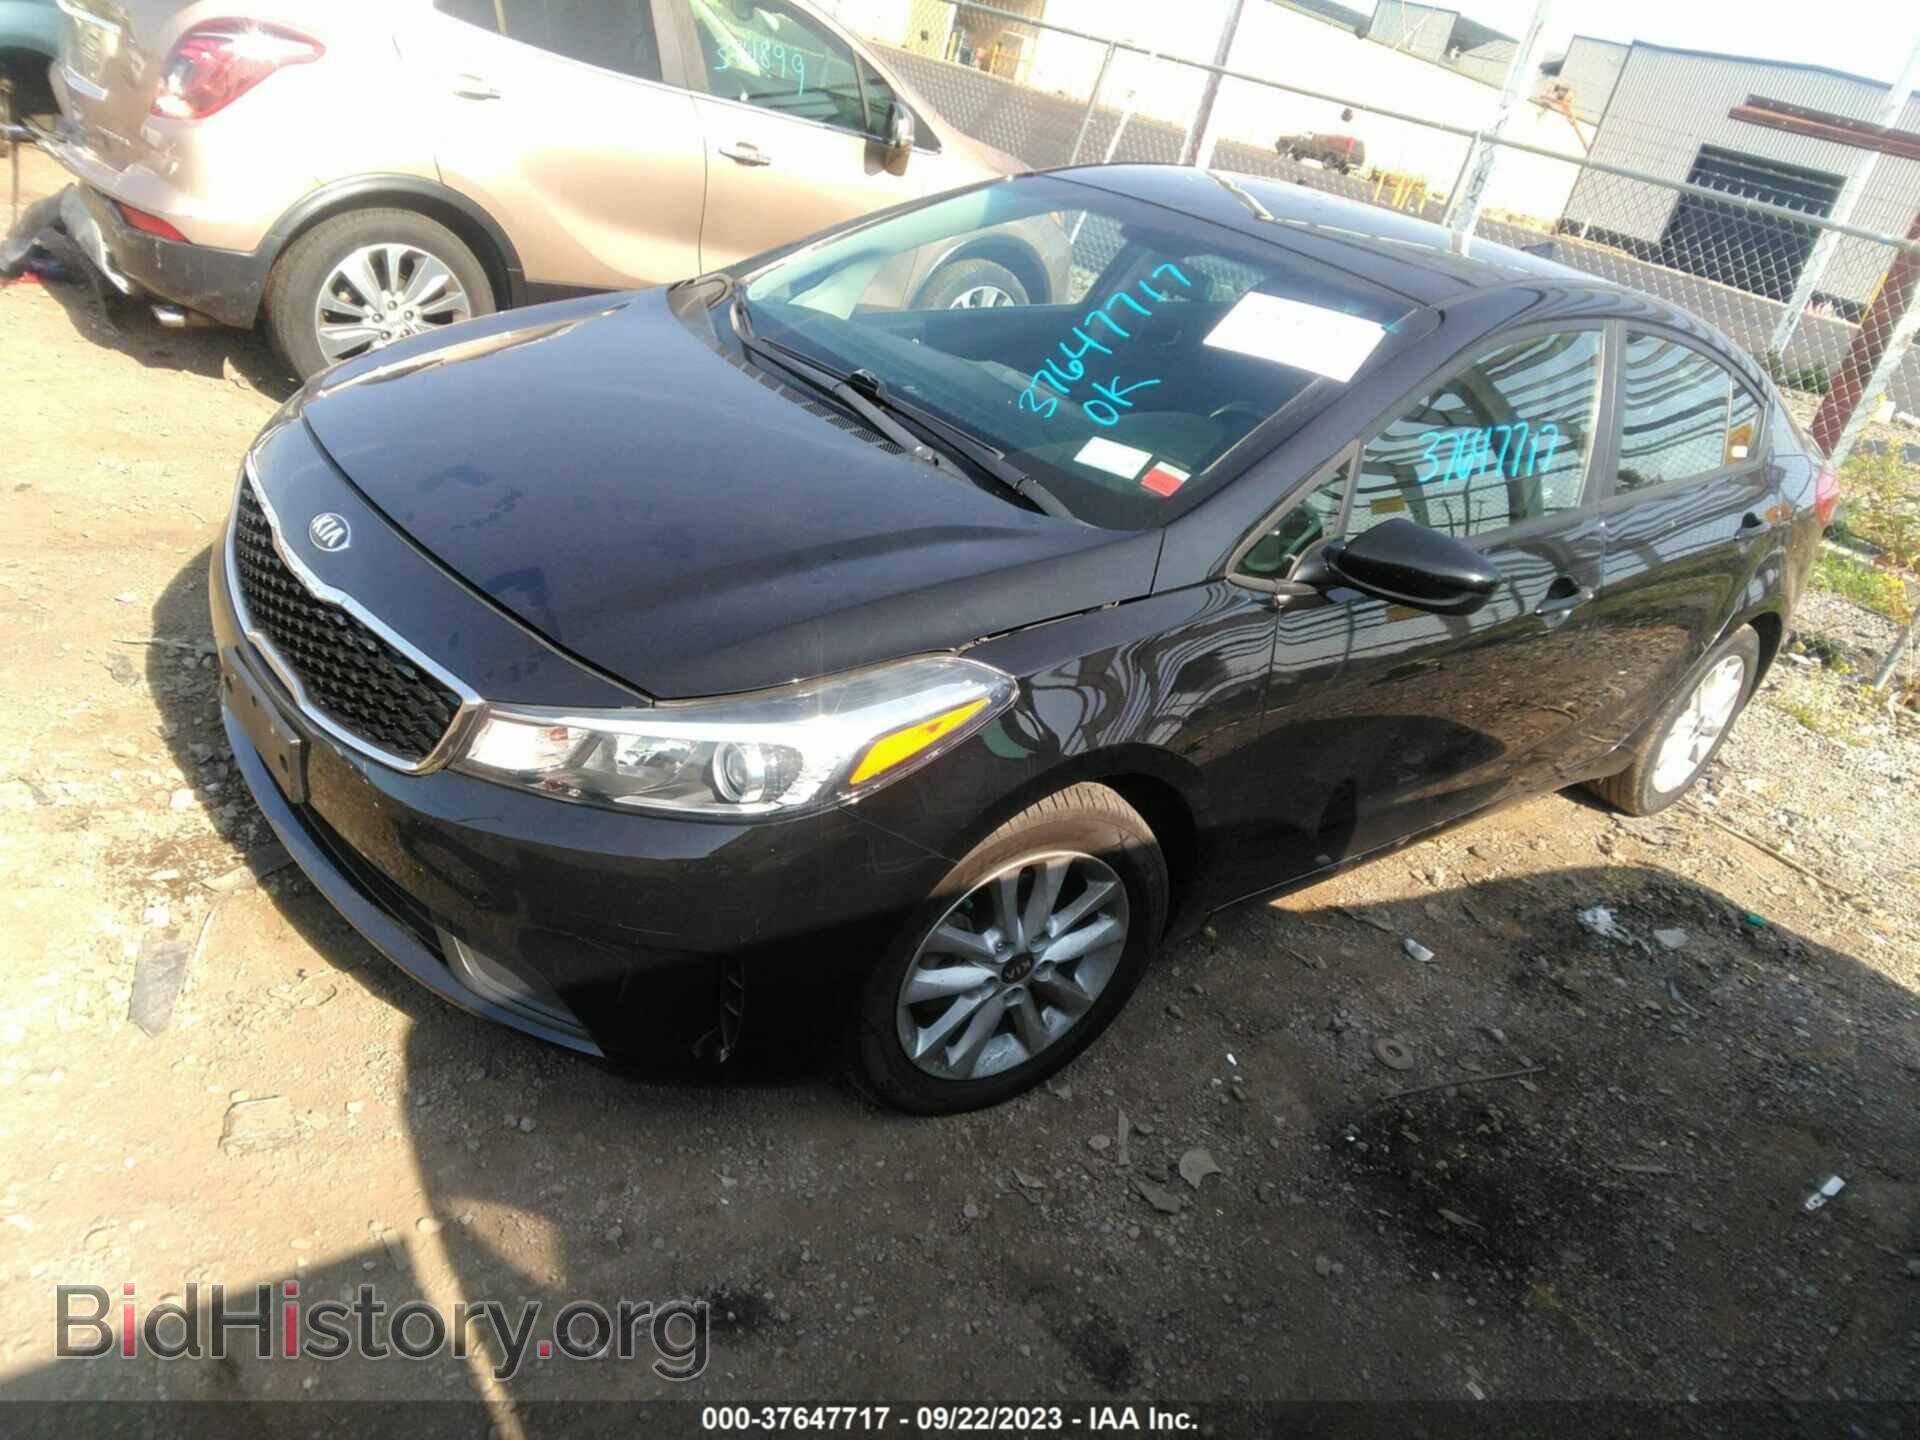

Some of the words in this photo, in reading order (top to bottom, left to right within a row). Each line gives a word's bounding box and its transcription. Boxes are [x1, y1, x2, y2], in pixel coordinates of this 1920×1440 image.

[1018, 263, 1193, 419] 37647717
[1082, 375, 1162, 426] OK
[311, 514, 347, 548] KIA
